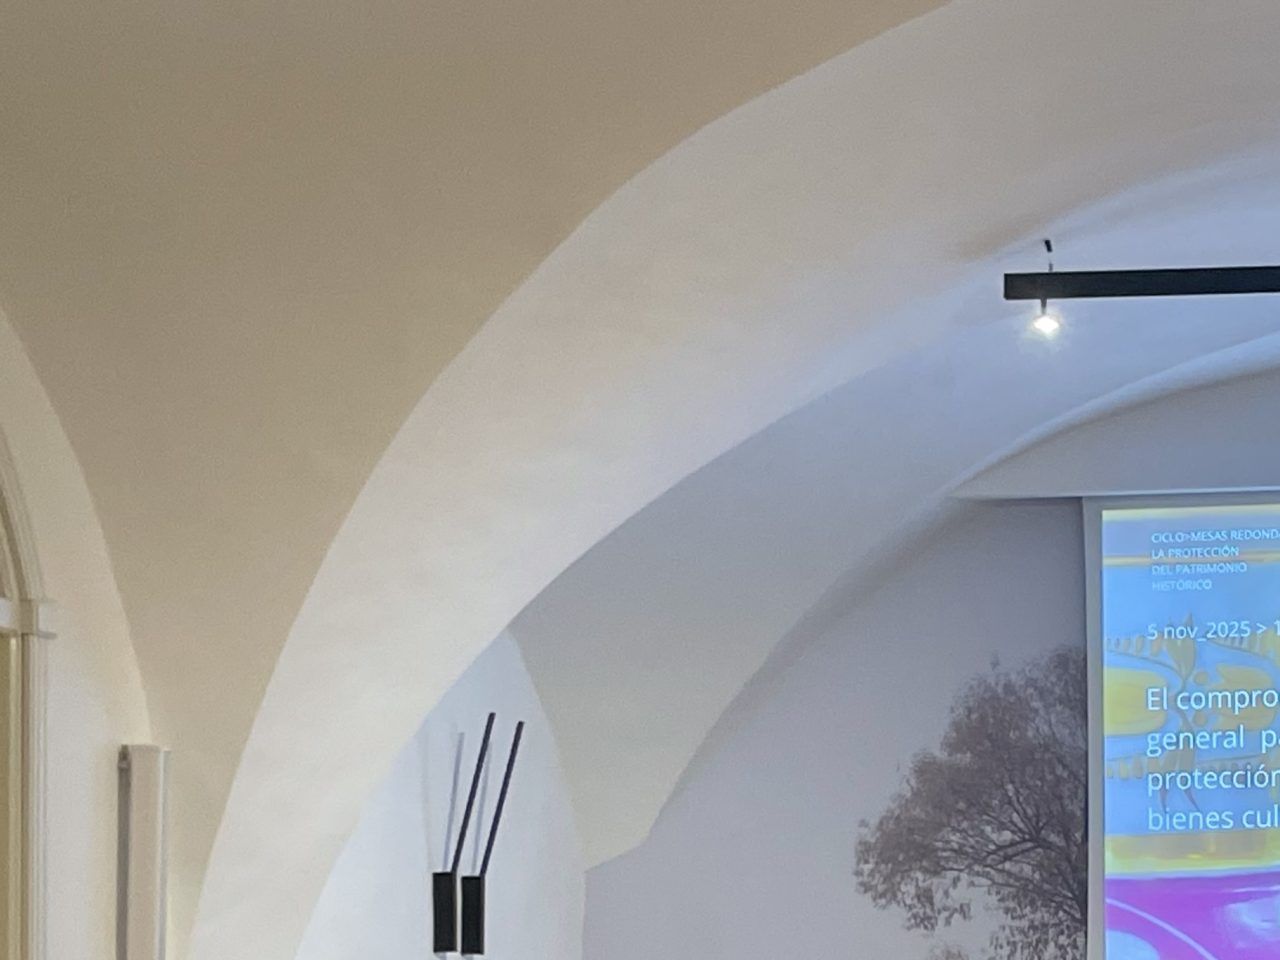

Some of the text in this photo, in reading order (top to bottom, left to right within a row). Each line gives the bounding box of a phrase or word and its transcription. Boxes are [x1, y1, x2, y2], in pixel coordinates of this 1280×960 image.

[1152, 544, 1240, 559] LA PROTECCIÓN
[1152, 562, 1248, 575] DEL PATRIMONIO
[1147, 624, 1158, 640] 5
[1146, 688, 1168, 711] El
[1146, 724, 1245, 757] general
[1148, 807, 1234, 831] bienes
